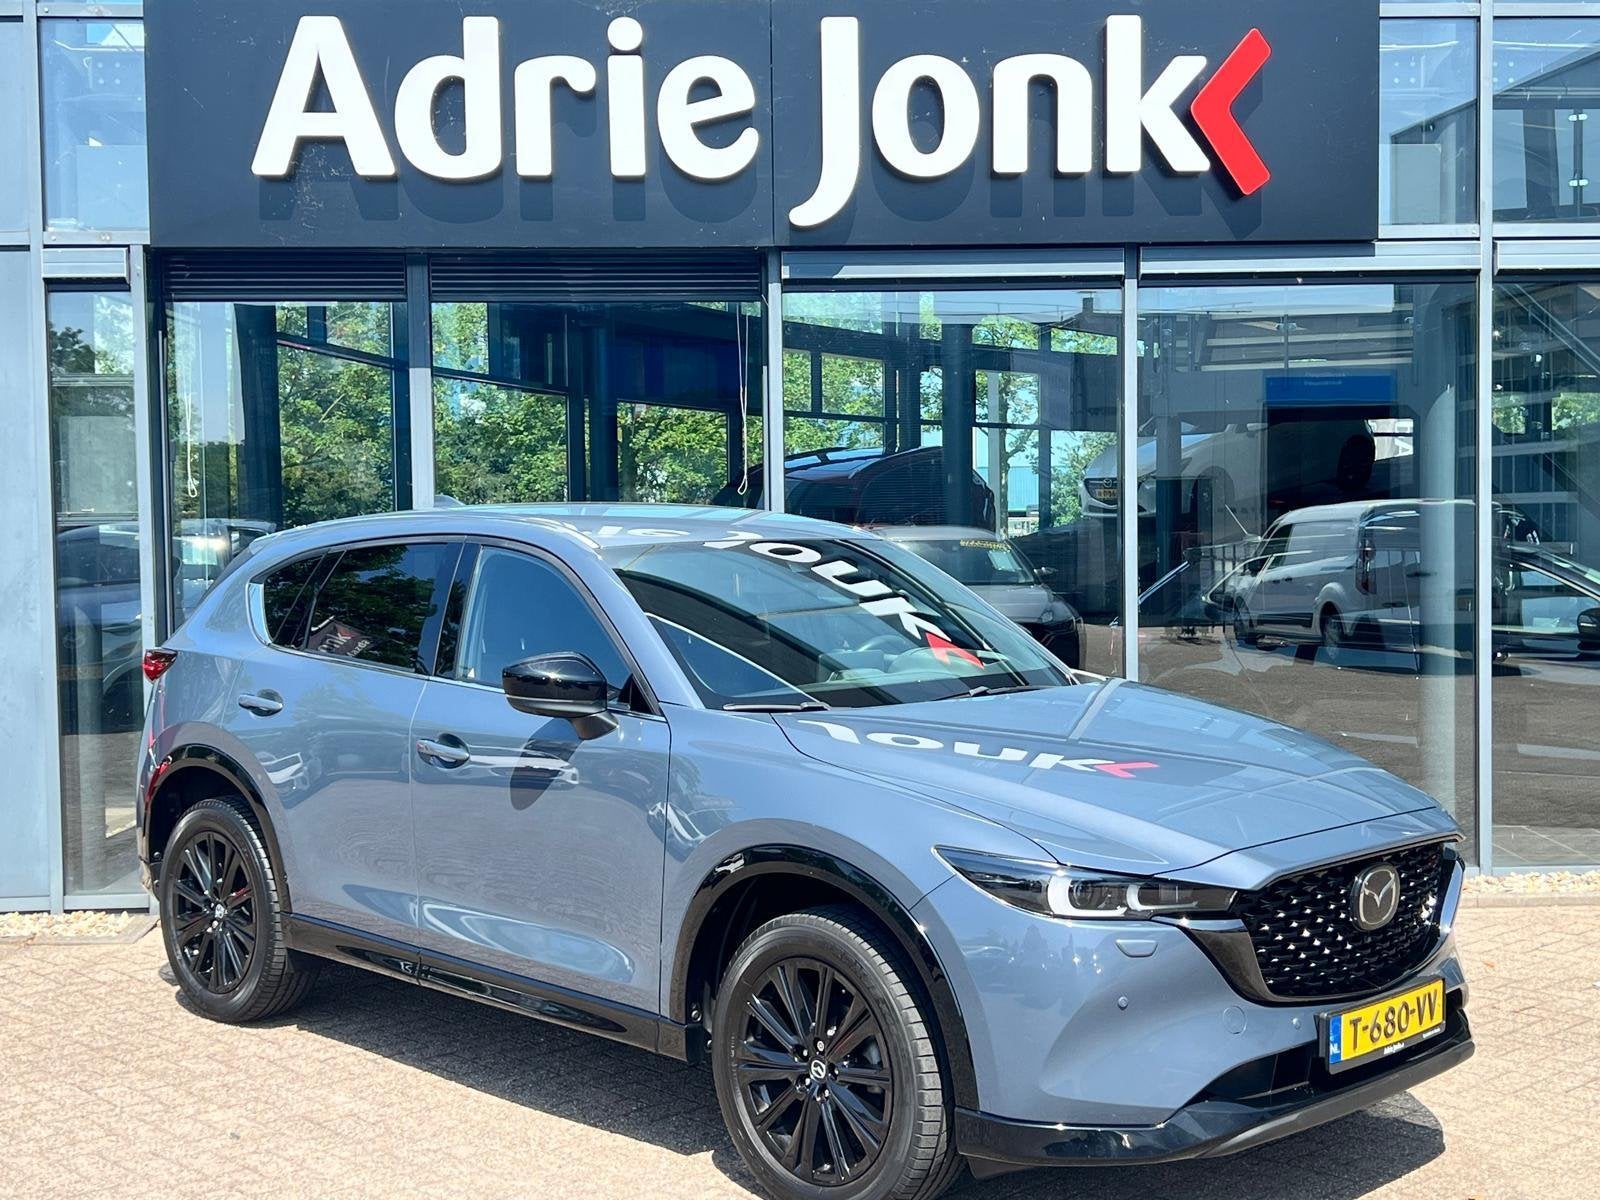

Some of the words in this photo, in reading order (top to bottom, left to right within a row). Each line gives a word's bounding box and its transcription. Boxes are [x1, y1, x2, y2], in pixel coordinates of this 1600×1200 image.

[251, 15, 760, 180] Adrie
[788, 14, 1212, 228] Jonk
[1330, 1043, 1341, 1055] NL
[1350, 989, 1438, 1052] T-680-VV
